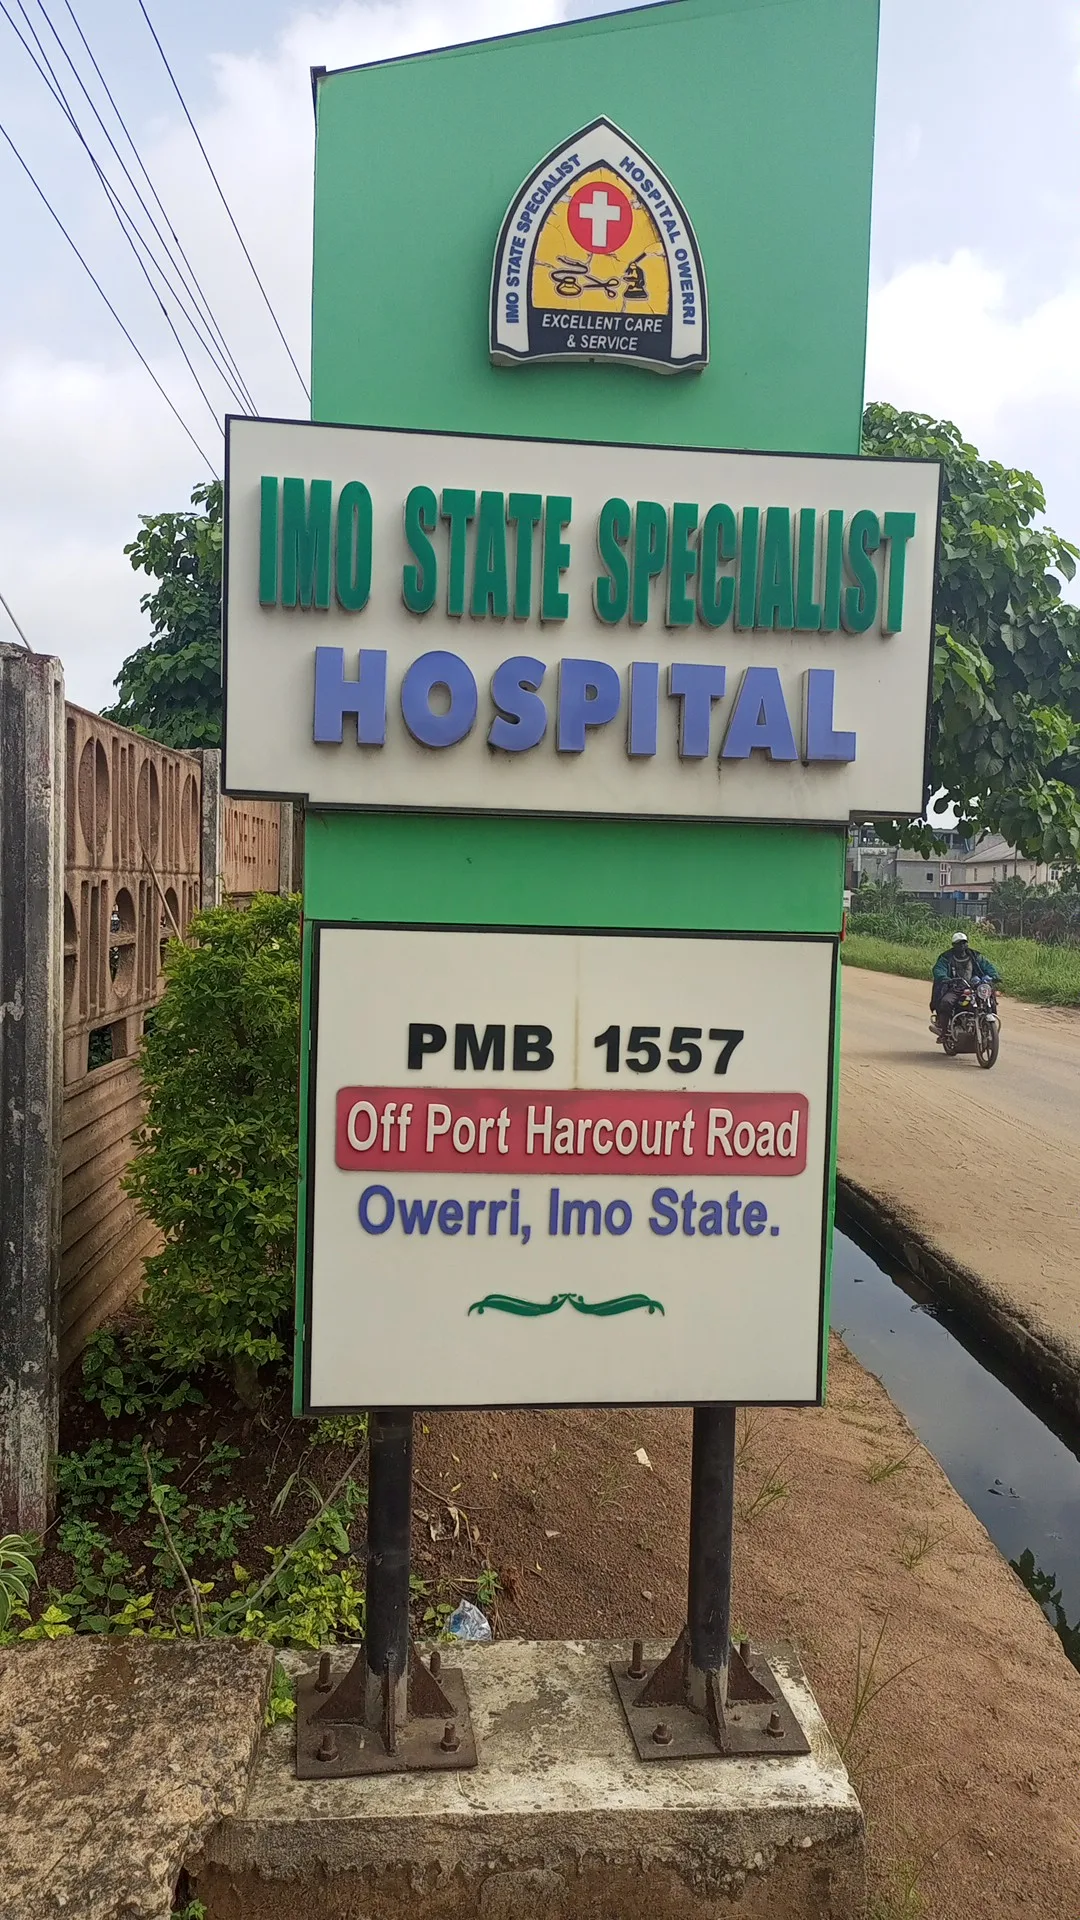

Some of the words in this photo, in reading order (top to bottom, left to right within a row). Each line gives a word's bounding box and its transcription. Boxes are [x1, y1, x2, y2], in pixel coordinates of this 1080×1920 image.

[517, 154, 581, 233] SPECIALIST
[506, 236, 526, 287] STATE
[619, 156, 681, 244] HOSPITAL
[675, 248, 696, 325] OWERRI
[506, 292, 519, 323] IMO
[542, 314, 622, 331] EXCELLENT
[624, 318, 663, 333] CARE
[567, 335, 577, 348] &
[580, 335, 639, 351] SERVICE
[259, 476, 373, 611] IMO
[402, 485, 572, 621] STATE
[594, 497, 915, 635] SPECIALIST
[313, 646, 857, 763] HOSPITAL
[407, 1023, 555, 1072] PMB
[594, 1025, 744, 1074] 1557
[347, 1101, 412, 1152] Off
[425, 1104, 510, 1154] Port
[526, 1105, 695, 1157] Harcourt
[706, 1108, 800, 1158] Road
[358, 1184, 532, 1244] Owerri,
[549, 1188, 632, 1237] Imo
[648, 1187, 779, 1237] State.
